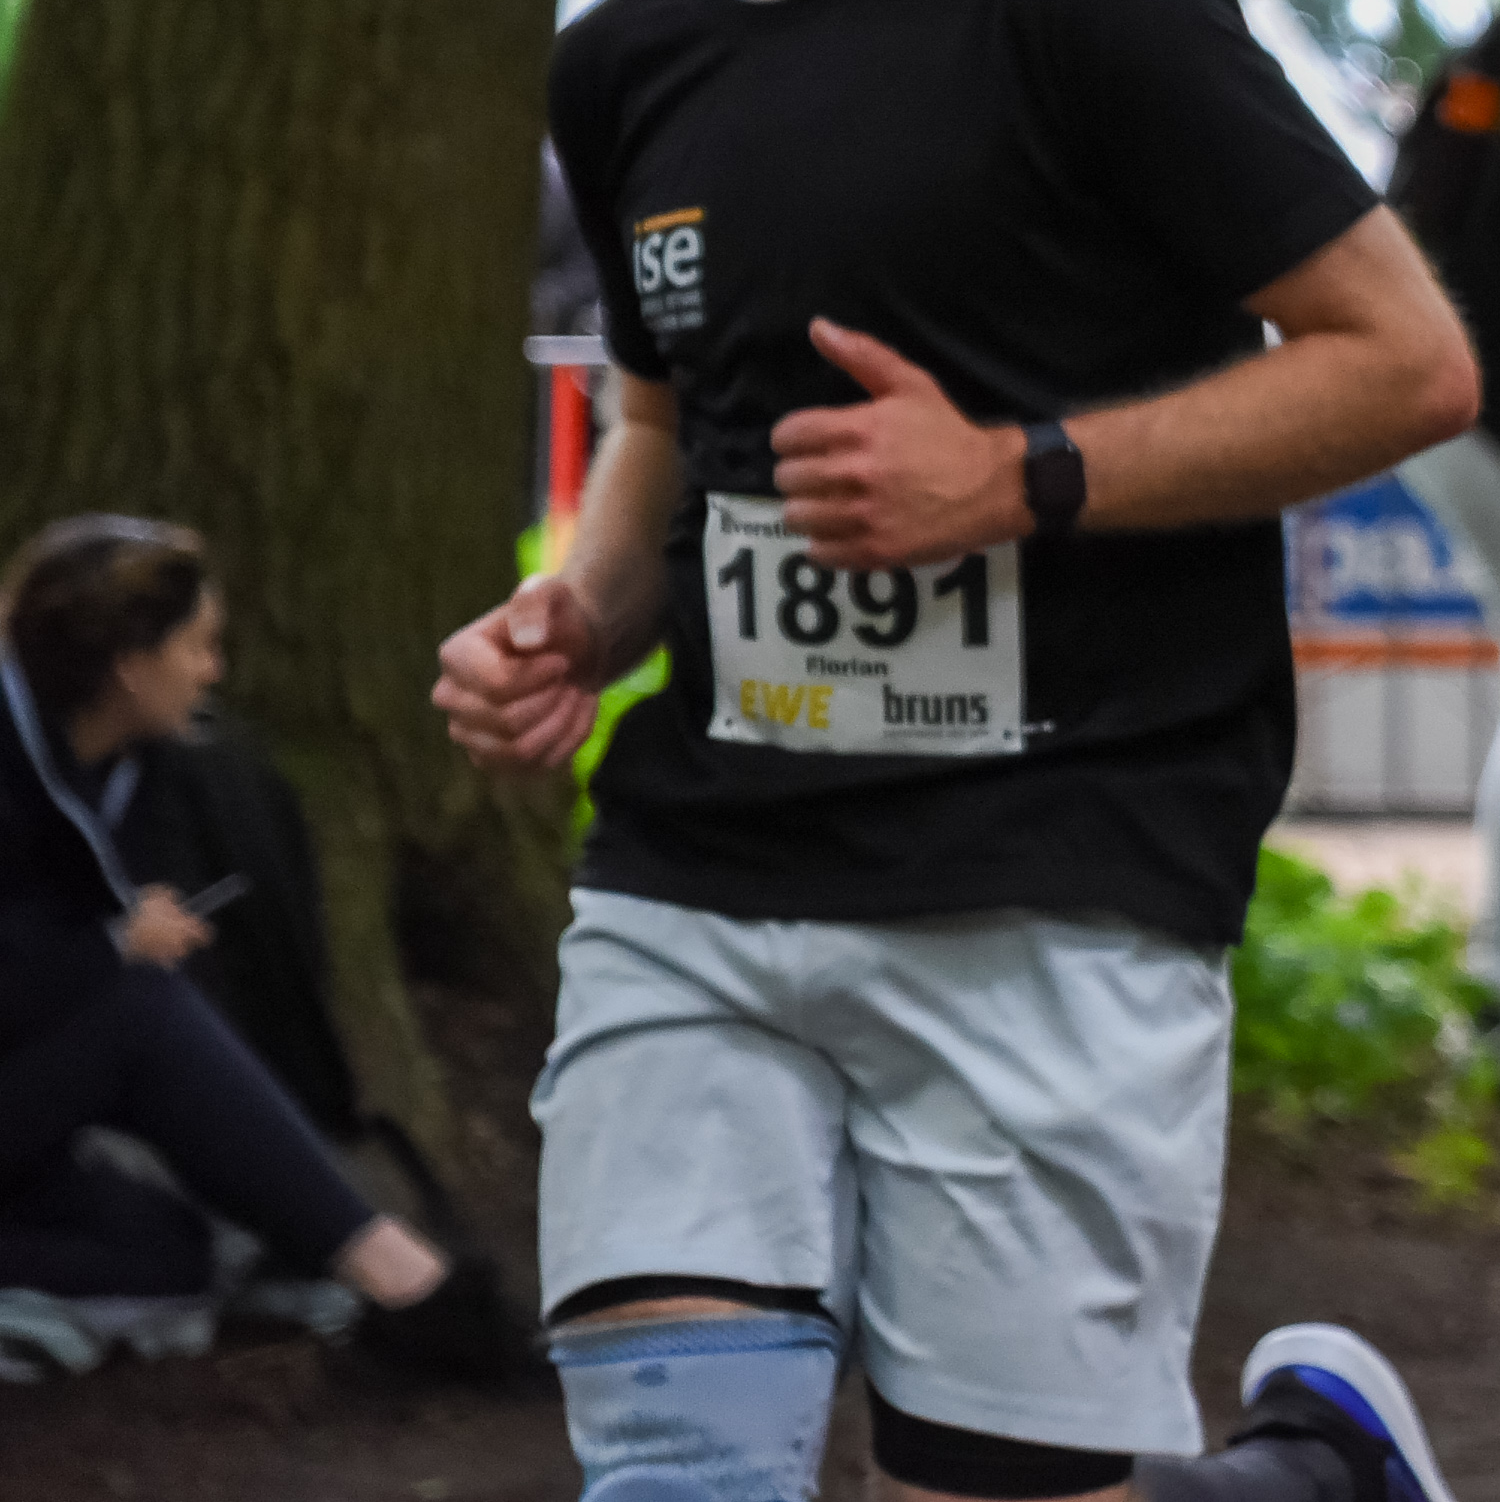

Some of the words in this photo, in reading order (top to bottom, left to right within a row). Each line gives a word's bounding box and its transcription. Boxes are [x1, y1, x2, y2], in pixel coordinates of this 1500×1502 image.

[718, 546, 990, 649] 1891
[806, 654, 888, 678] Florian
[740, 679, 834, 729] EWE
[882, 683, 988, 726] bruns
